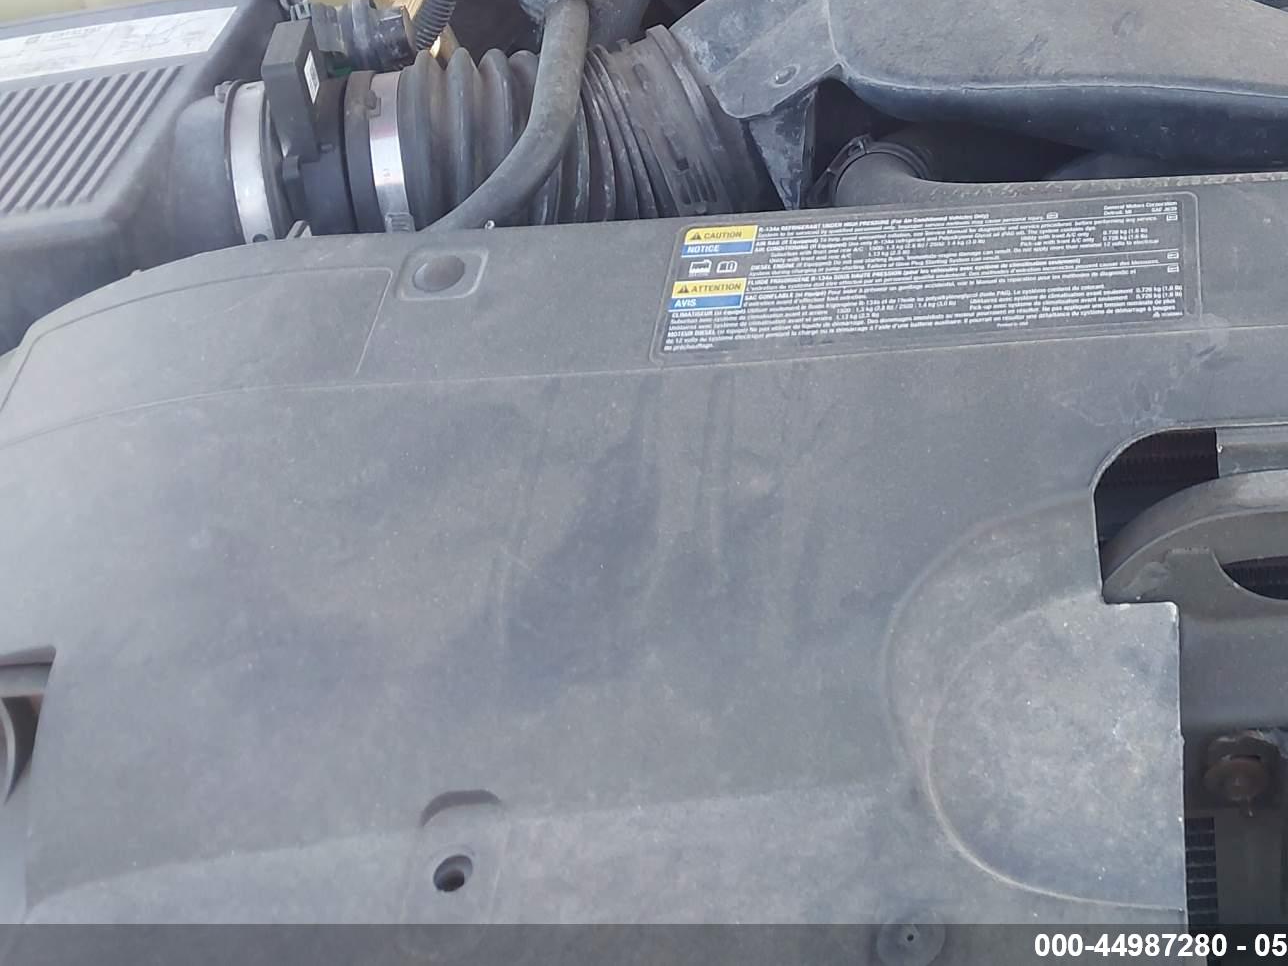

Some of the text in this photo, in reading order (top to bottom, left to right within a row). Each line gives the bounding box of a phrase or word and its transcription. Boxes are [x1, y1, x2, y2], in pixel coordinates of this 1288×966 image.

[703, 231, 743, 240] CAUTION
[686, 245, 721, 253] NOTICE
[691, 283, 742, 293] ATTENTION
[674, 298, 697, 307] AVIS
